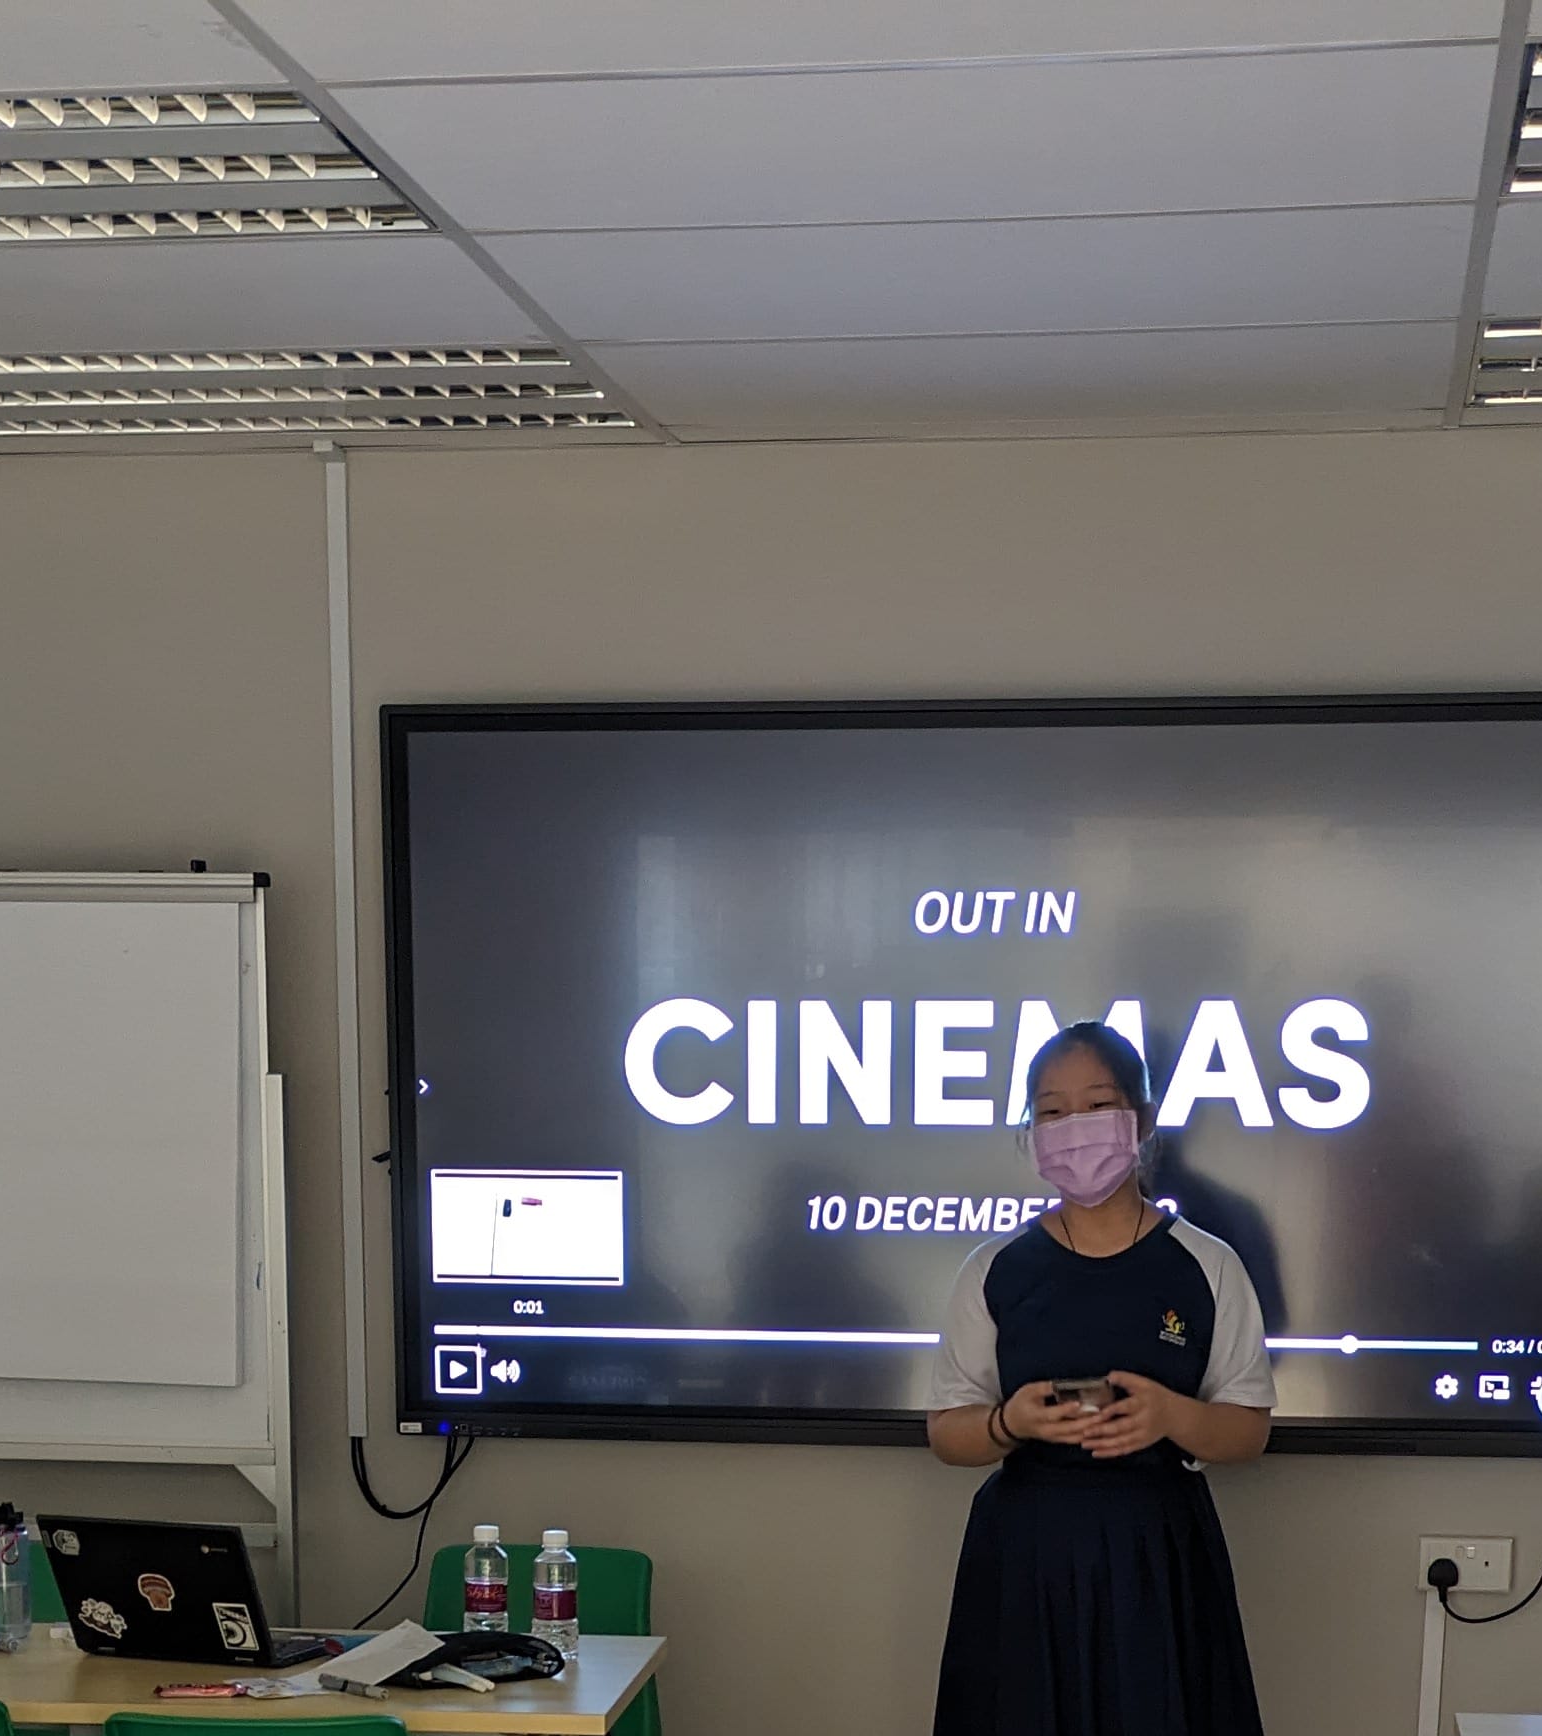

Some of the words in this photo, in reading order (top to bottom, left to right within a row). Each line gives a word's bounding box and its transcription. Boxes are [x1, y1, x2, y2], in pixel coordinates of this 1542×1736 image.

[915, 891, 1015, 934] OUT
[1025, 891, 1075, 933] IN
[808, 1196, 847, 1230] 10
[855, 1197, 1062, 1232] DECEMBE
[513, 1300, 544, 1314] 0:01
[1492, 1339, 1524, 1354] 0:34
